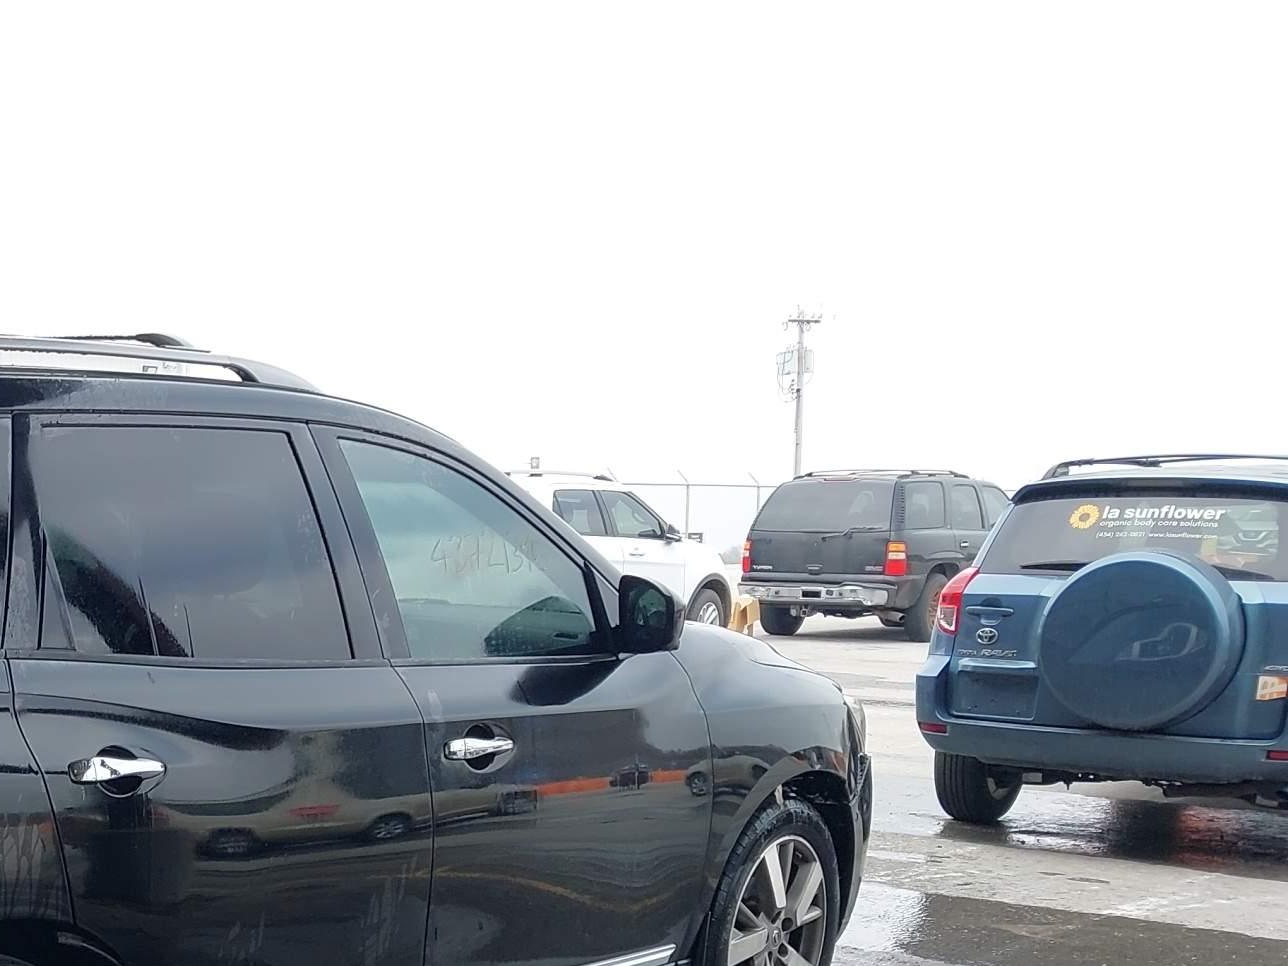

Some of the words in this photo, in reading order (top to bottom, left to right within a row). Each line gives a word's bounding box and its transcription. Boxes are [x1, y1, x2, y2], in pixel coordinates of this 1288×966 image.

[1102, 505, 1121, 519] la
[1123, 505, 1226, 520] sunflower
[1099, 519, 1132, 528] organic
[1134, 518, 1156, 528] body
[1179, 519, 1219, 528] solutions
